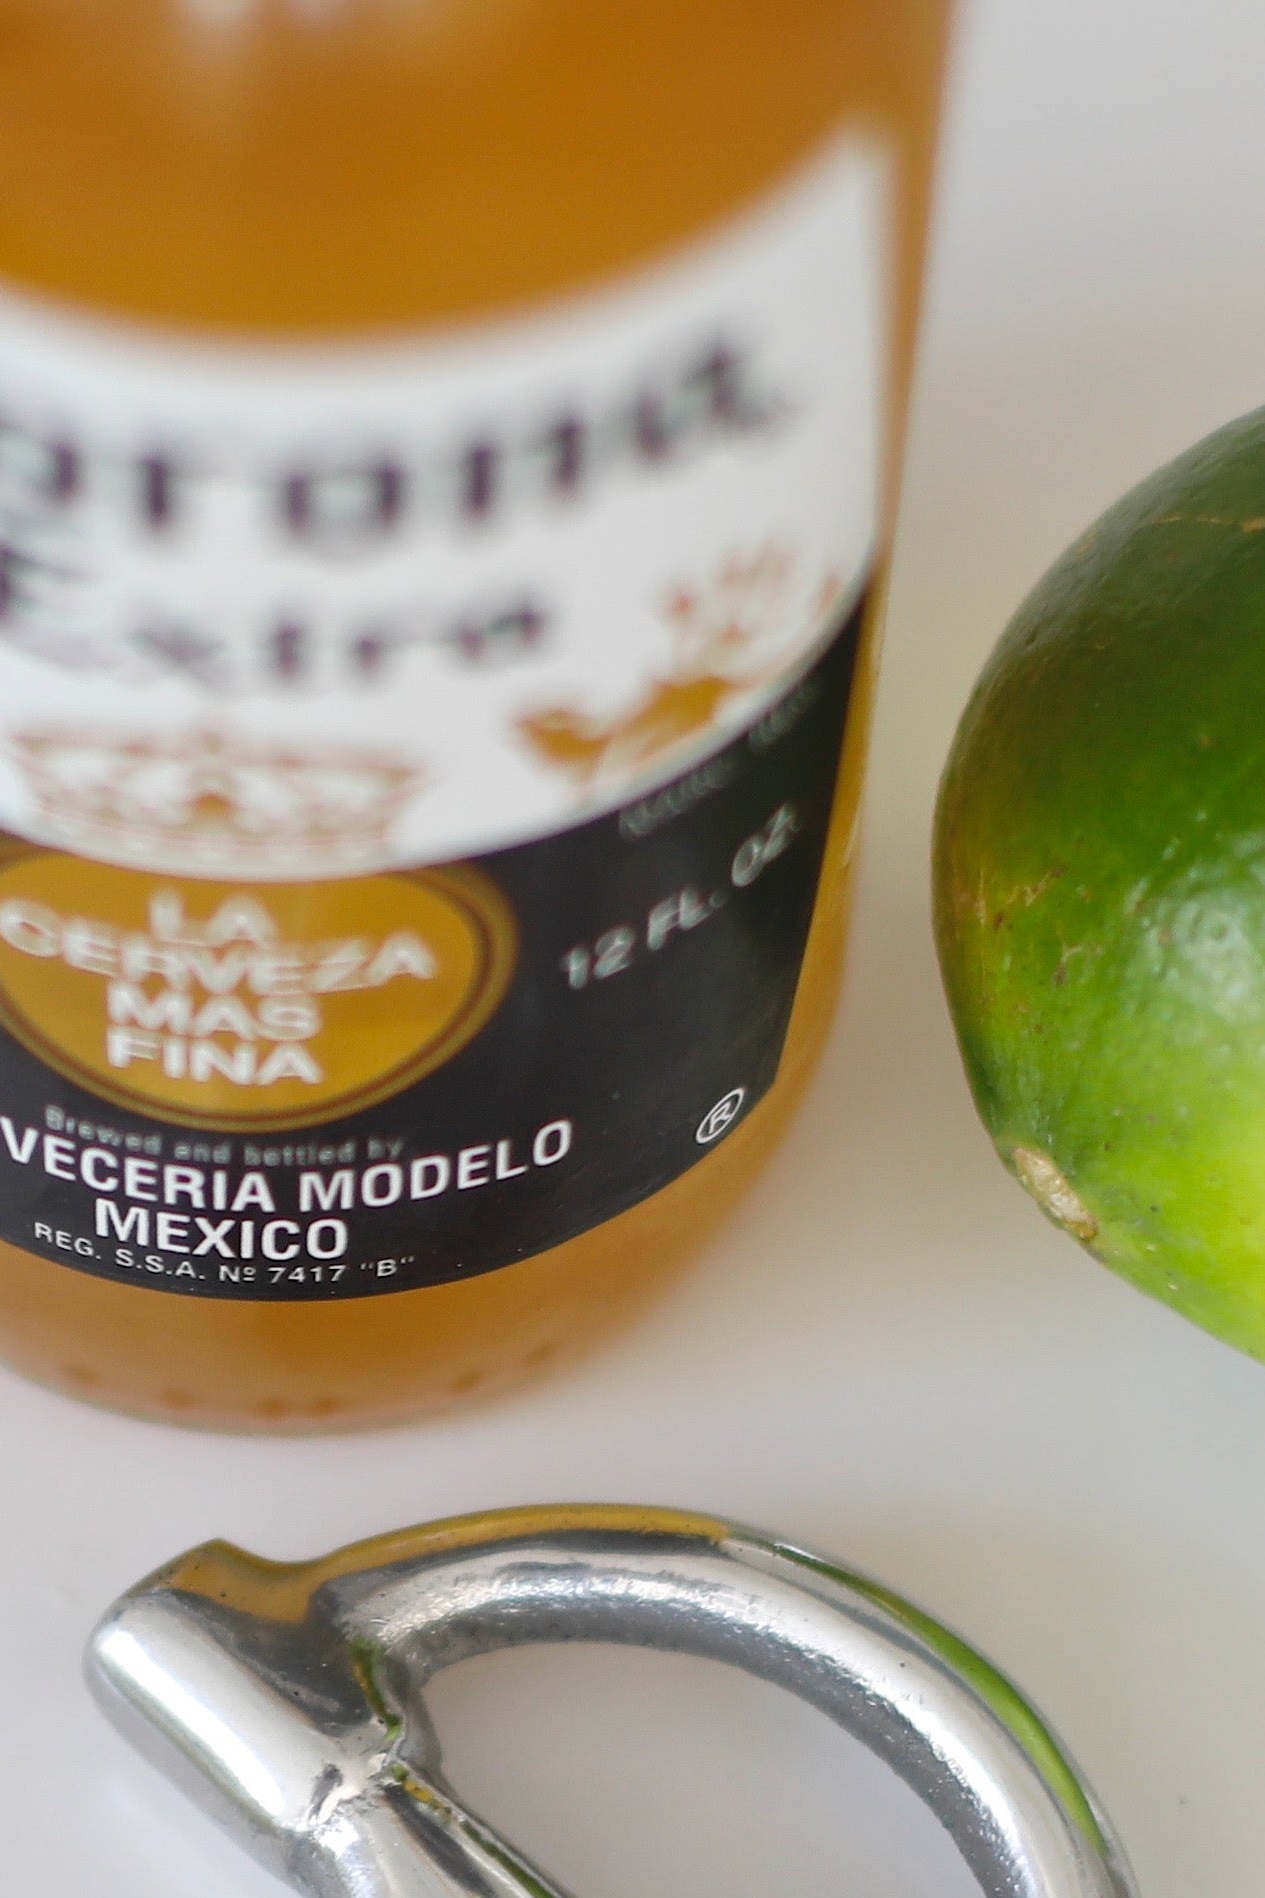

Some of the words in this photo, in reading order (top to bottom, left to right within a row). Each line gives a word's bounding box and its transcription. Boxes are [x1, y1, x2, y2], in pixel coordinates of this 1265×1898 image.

[148, 886, 277, 947] LA
[561, 925, 637, 989] 12
[647, 887, 727, 952] FL.
[106, 975, 323, 1041] MAS
[106, 1022, 324, 1086] FINA
[45, 1105, 162, 1153] Brewed
[173, 1140, 232, 1164] and
[243, 1138, 354, 1167] bottled
[299, 1119, 573, 1213] MODELO
[35, 1222, 102, 1260] REG.
[115, 1248, 206, 1280] S.S.A.
[268, 1264, 347, 1283] 7417
[95, 1197, 348, 1261] MEXICO
